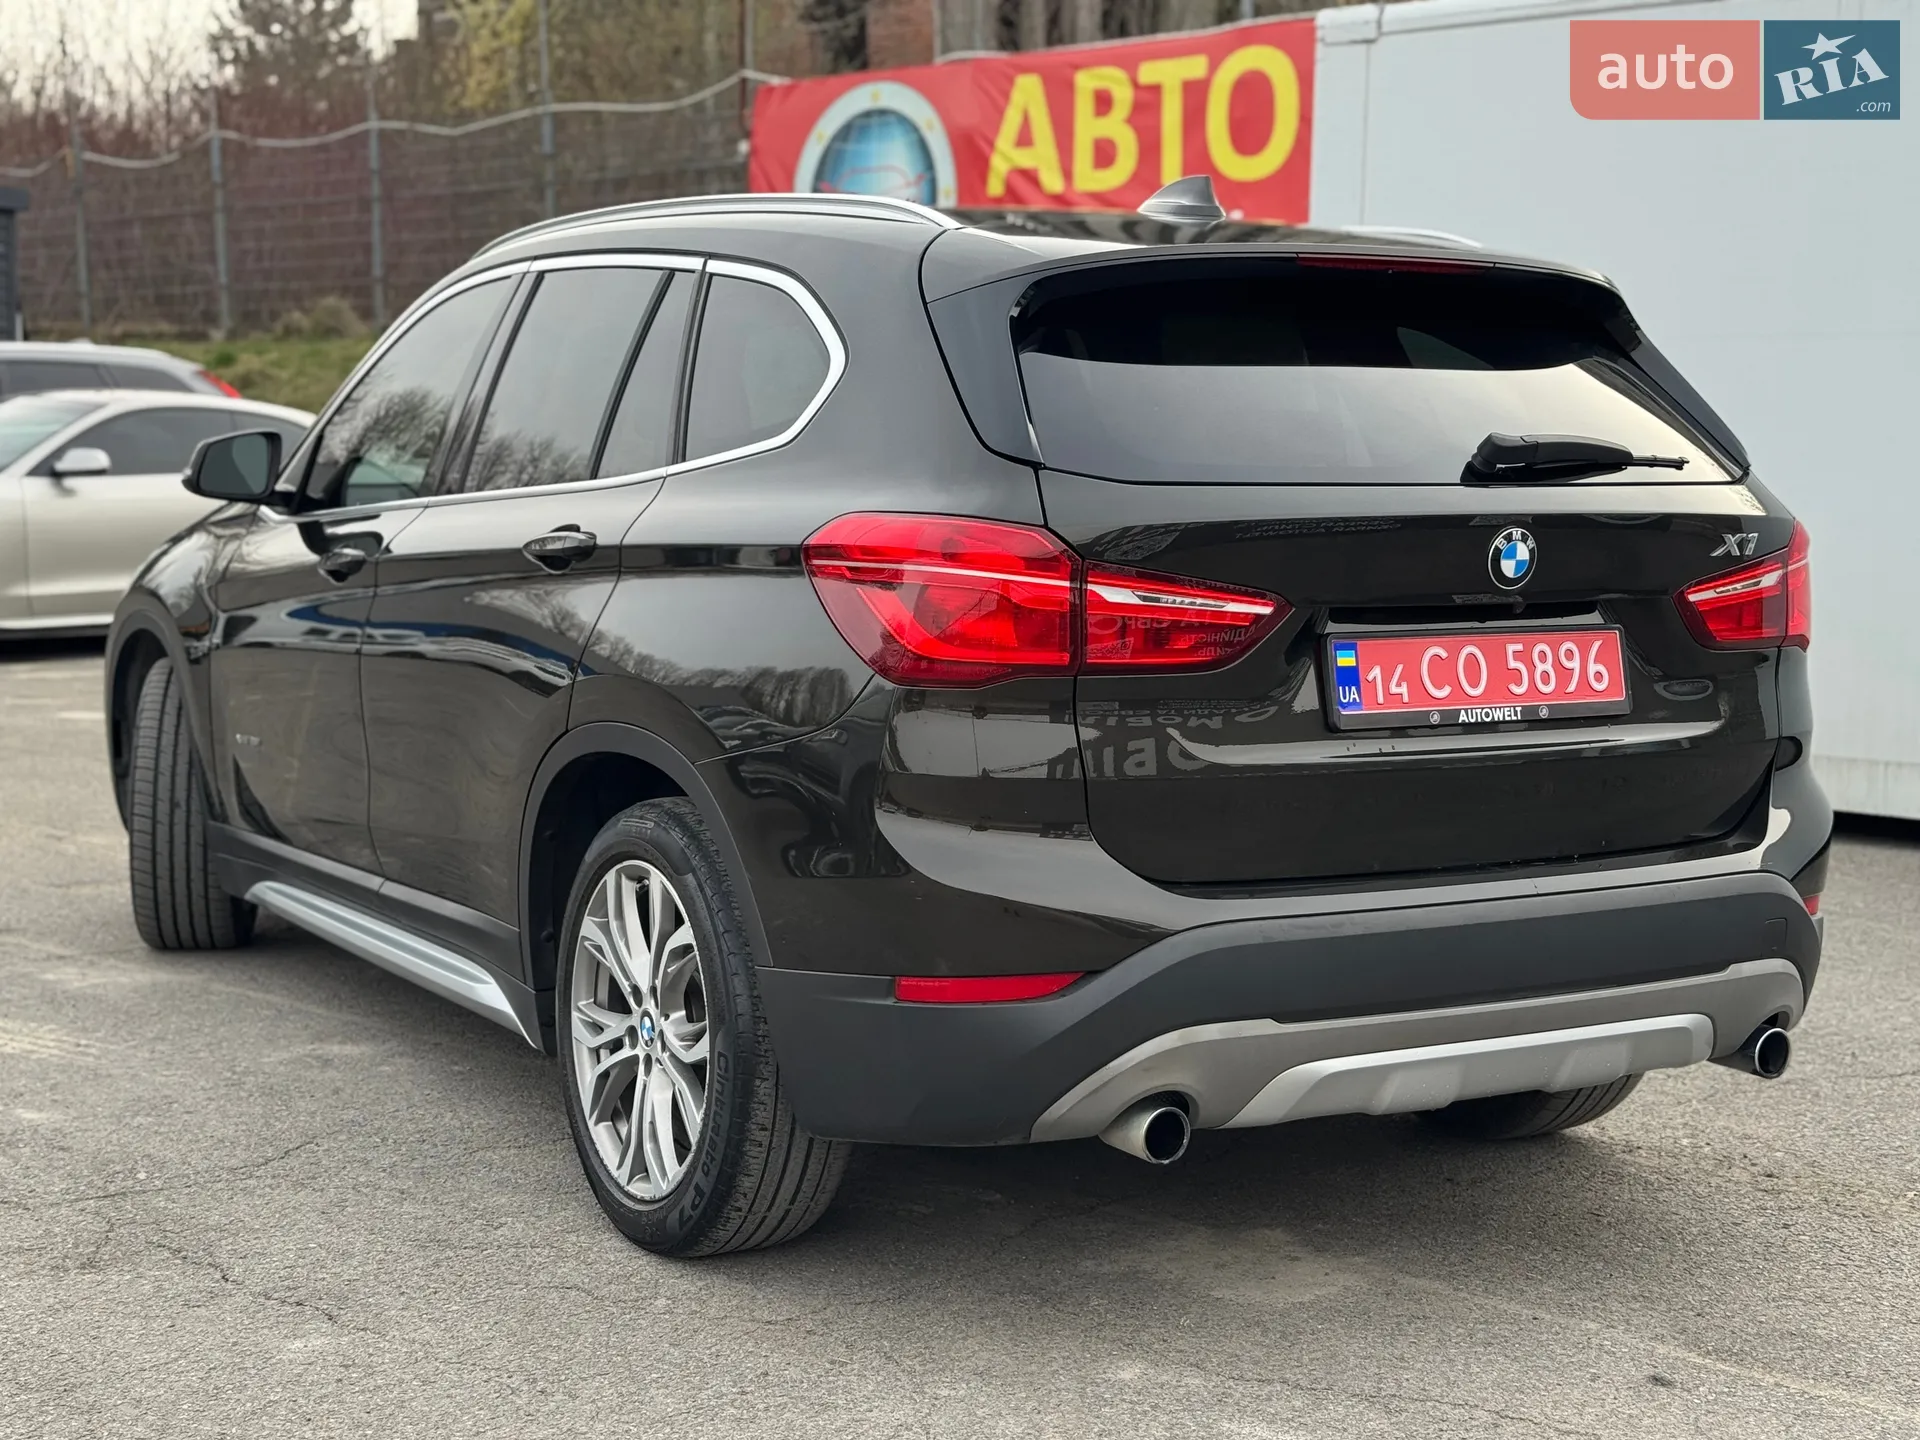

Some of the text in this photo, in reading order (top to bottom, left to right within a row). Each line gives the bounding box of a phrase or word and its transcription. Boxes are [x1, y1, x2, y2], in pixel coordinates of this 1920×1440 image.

[987, 45, 1300, 197] АВТО
[1709, 532, 1759, 557] X1
[1365, 639, 1610, 705] 14 CO 5896
[1338, 685, 1361, 703] UA
[1458, 706, 1523, 724] AUTOWELT
[677, 1181, 707, 1233] P7
